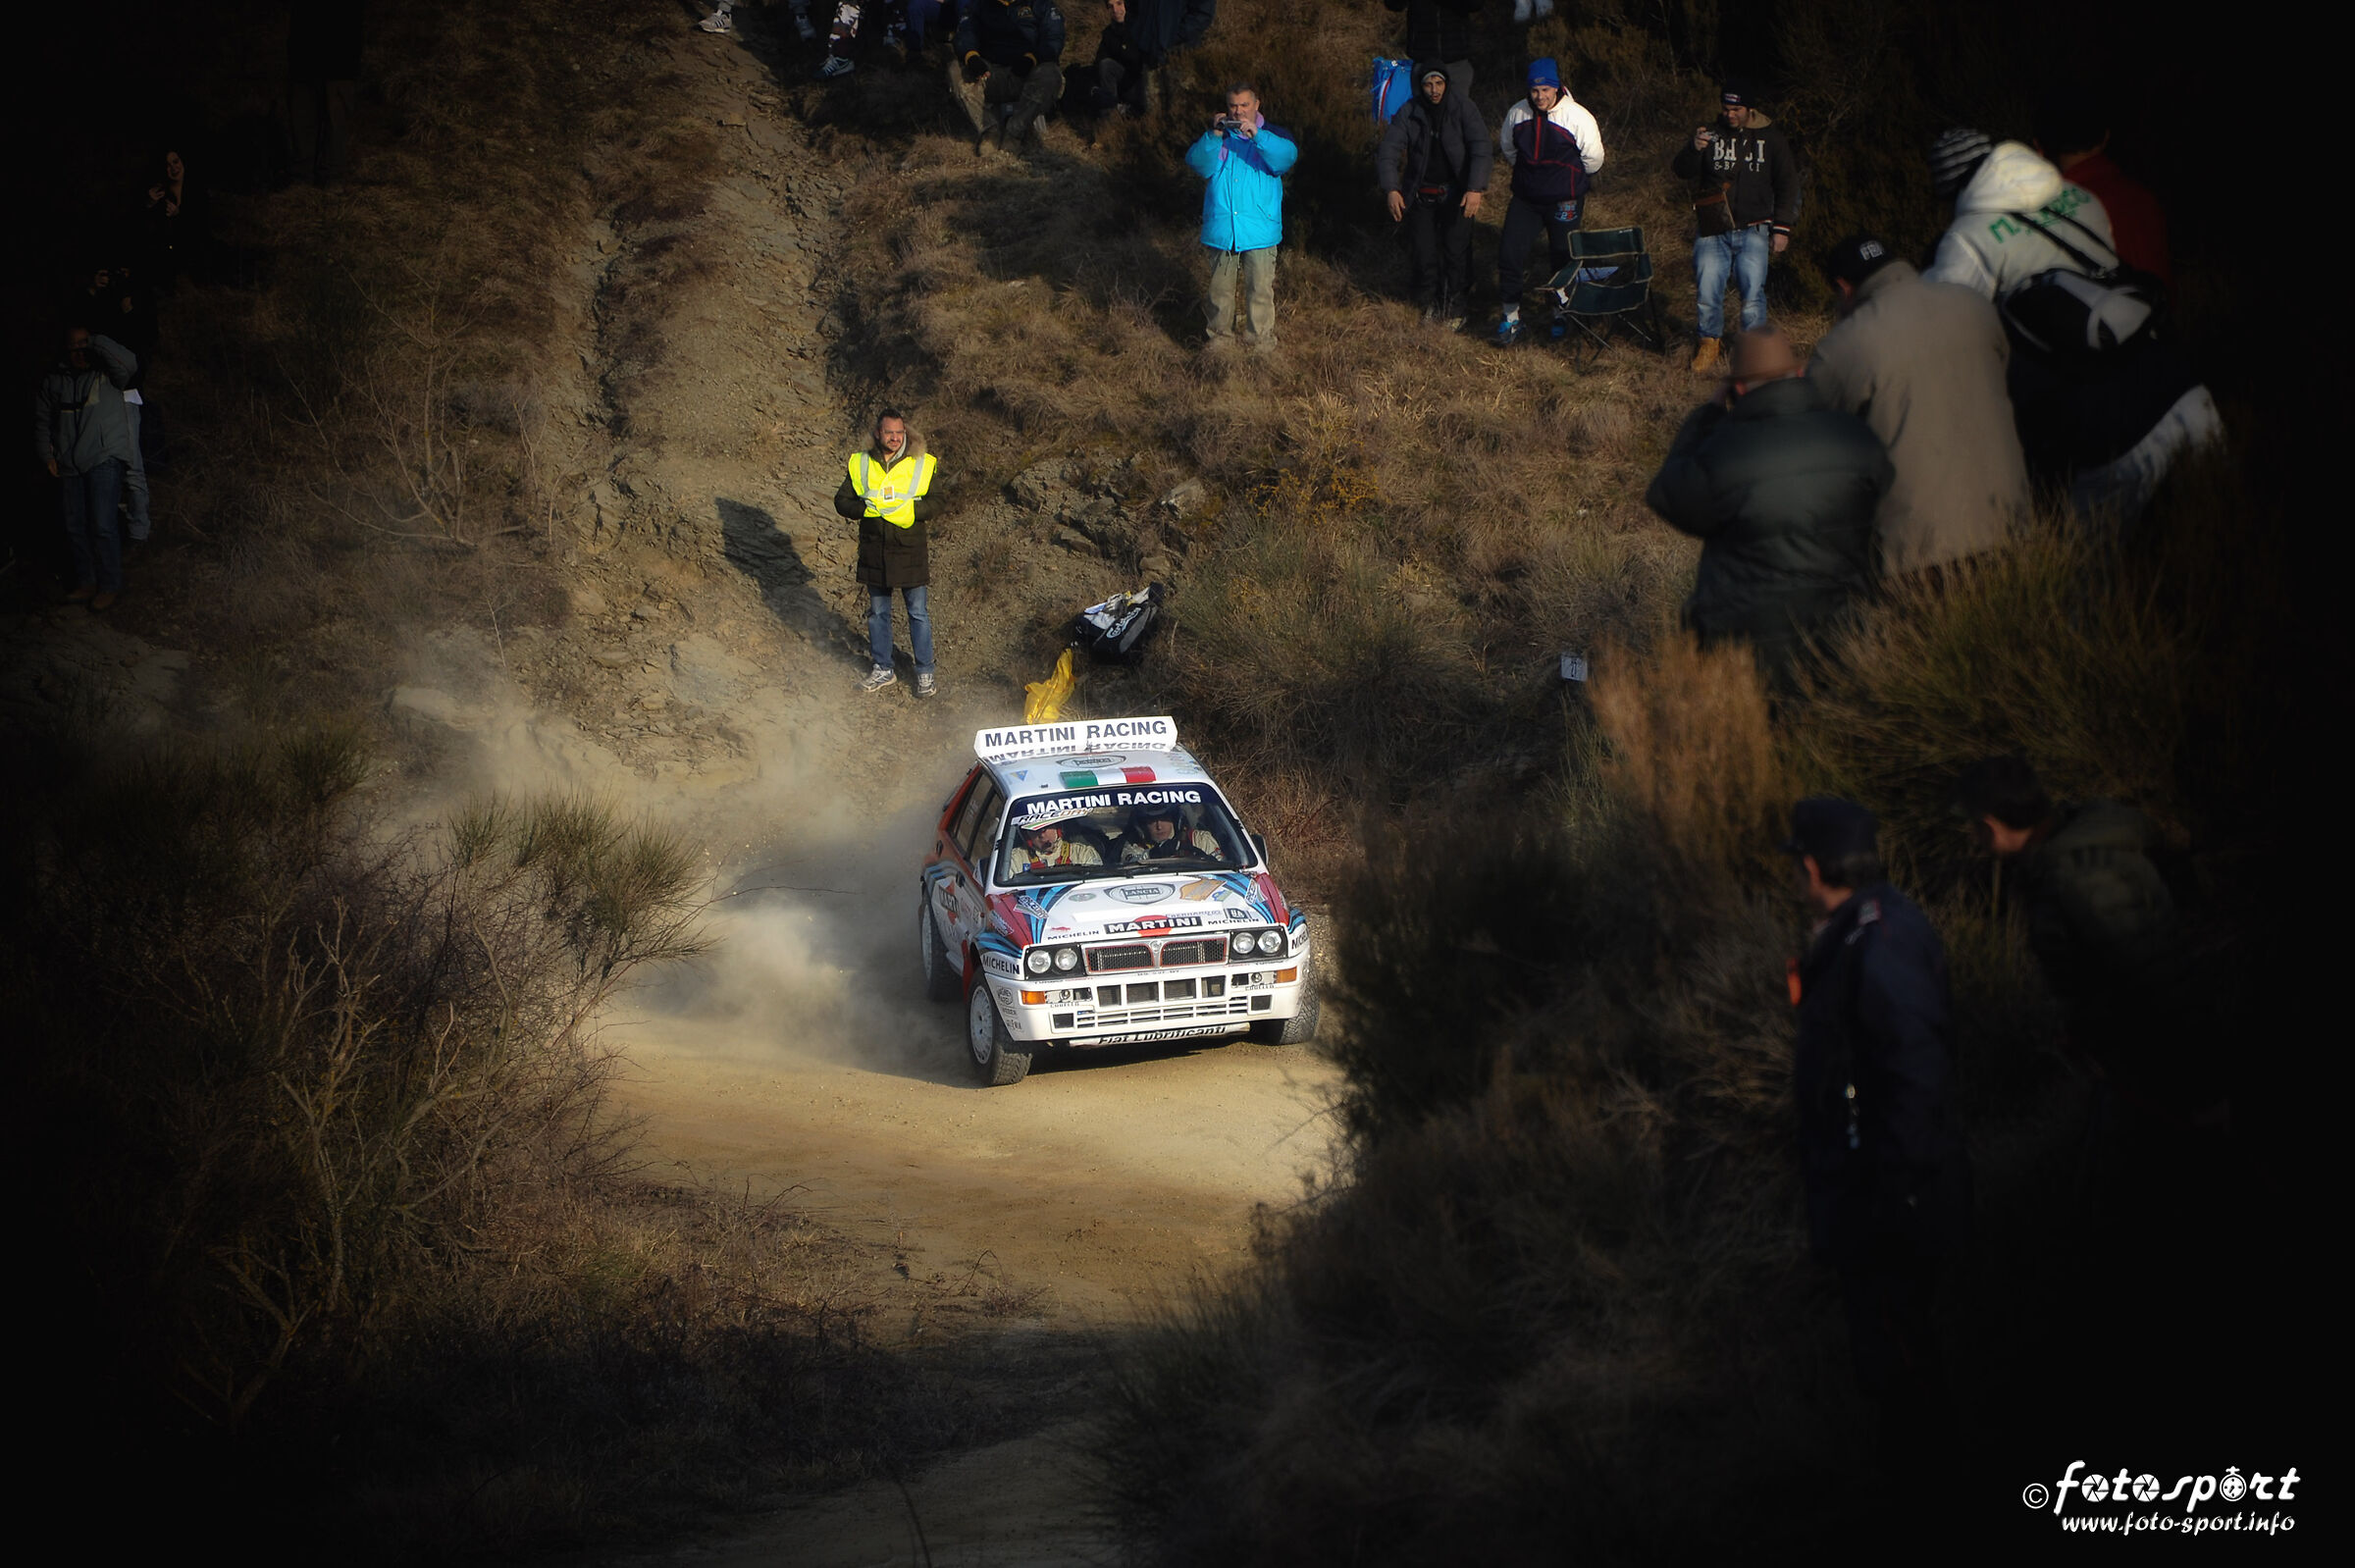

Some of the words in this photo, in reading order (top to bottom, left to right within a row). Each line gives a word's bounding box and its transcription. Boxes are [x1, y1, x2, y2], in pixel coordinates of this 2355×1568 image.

[985, 726, 1075, 748] MARTINI
[1086, 720, 1167, 739] RACING
[1026, 794, 1111, 814] MARTINI
[1117, 790, 1202, 806] RACING
[1125, 888, 1160, 897] LANCIA
[1109, 916, 1197, 933] MARTINI
[1047, 930, 1099, 940] MICHELIN
[983, 954, 1020, 975] MICHELIN
